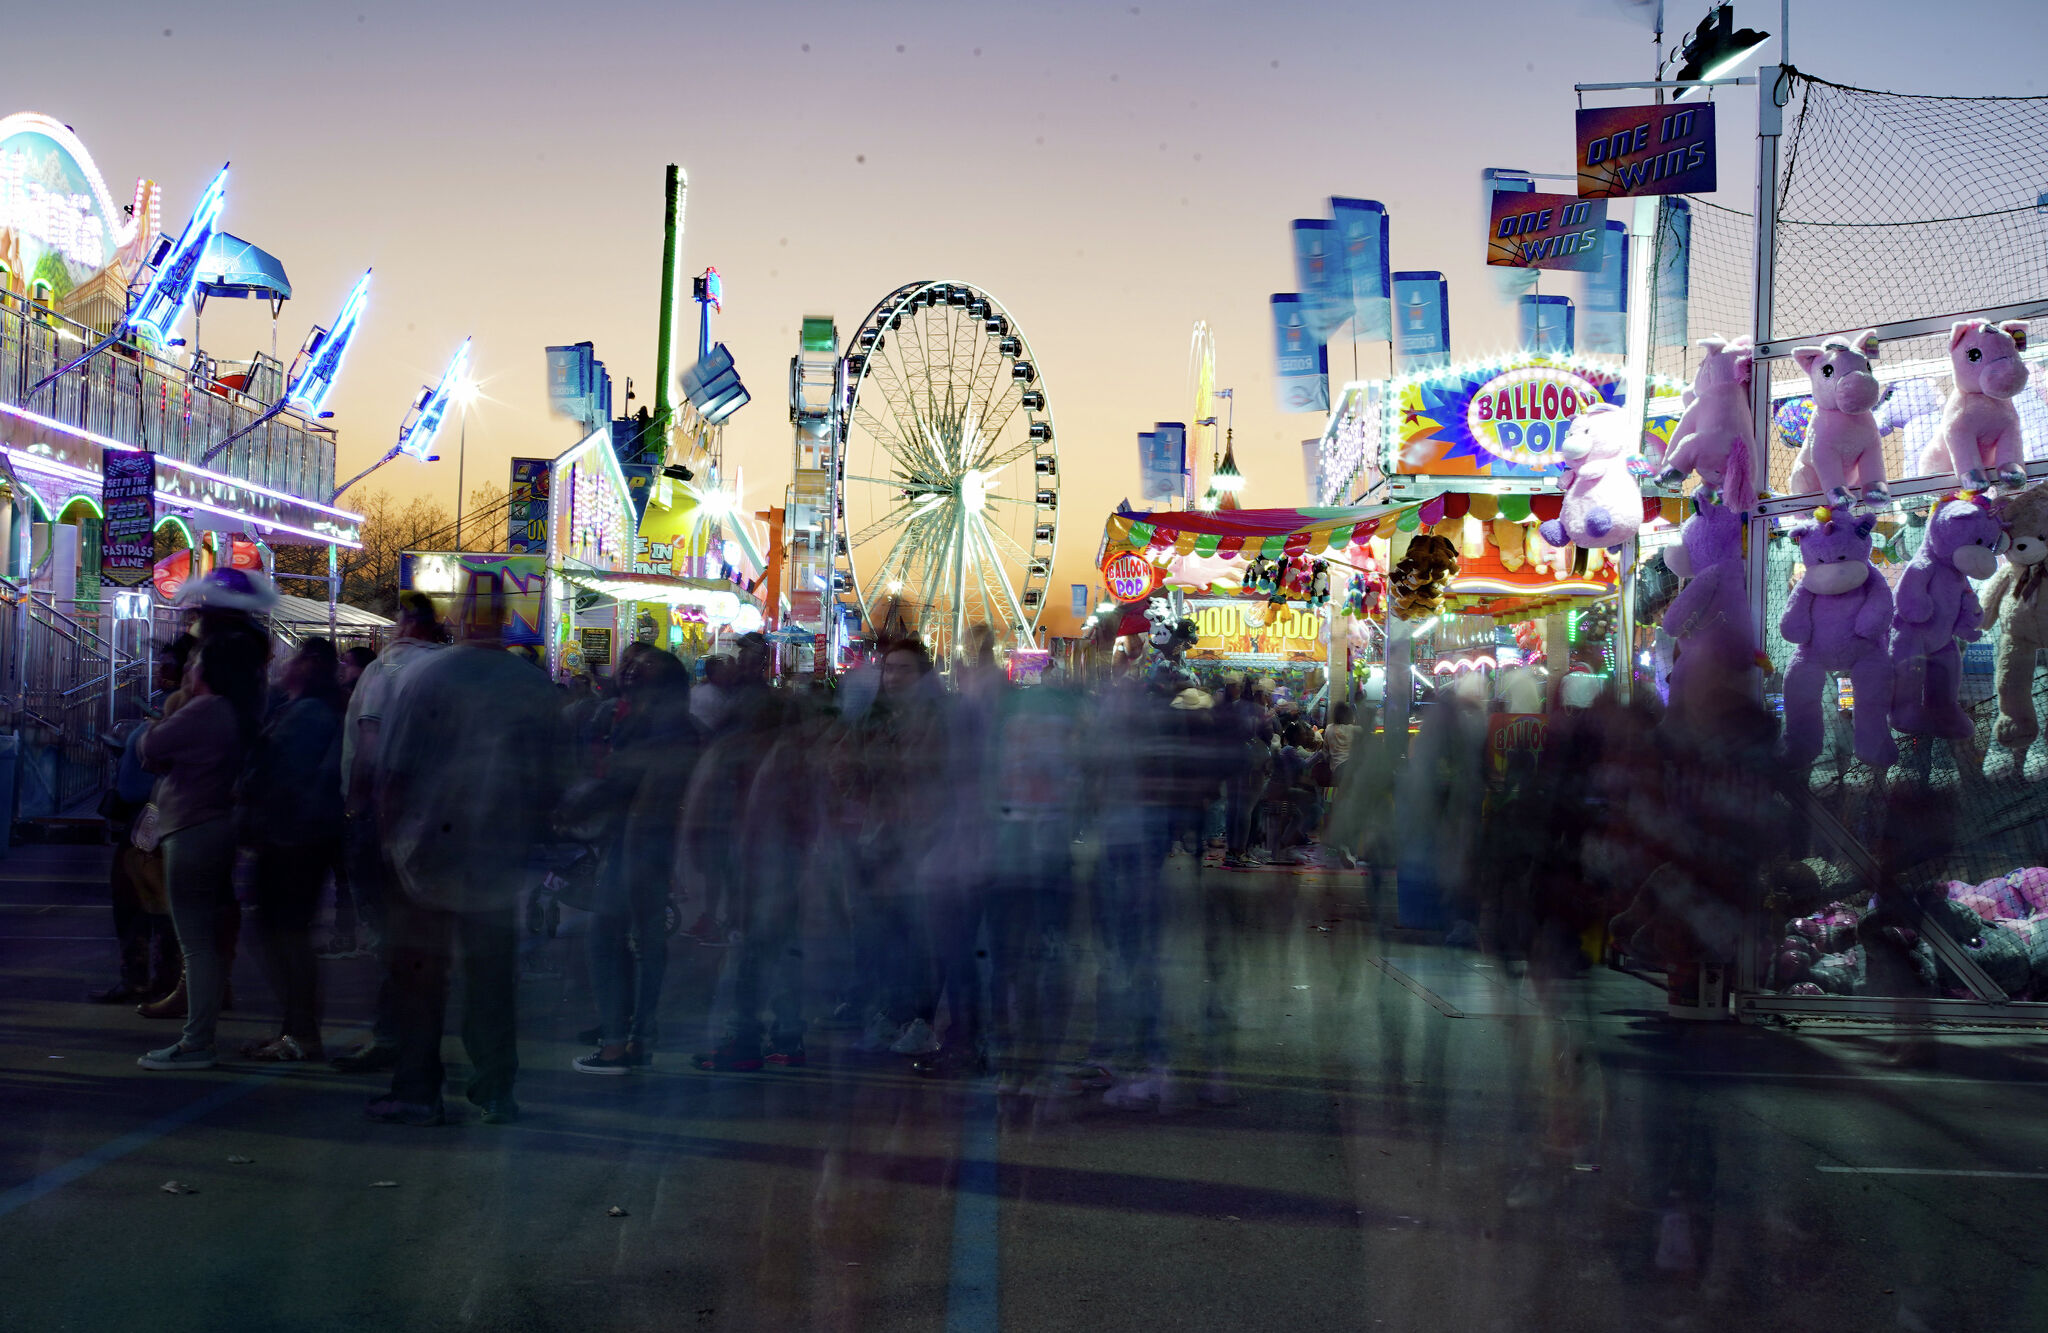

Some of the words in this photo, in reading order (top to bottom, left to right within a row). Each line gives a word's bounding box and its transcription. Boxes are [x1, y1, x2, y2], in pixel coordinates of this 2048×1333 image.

[1587, 123, 1649, 166] ONE
[1660, 109, 1695, 144] IN
[1617, 141, 1706, 191] WINS
[1497, 208, 1553, 238] ONE
[1560, 201, 1592, 227] IN
[1522, 228, 1598, 262] WINS
[106, 478, 121, 489] GET
[122, 477, 132, 487] IN
[133, 476, 147, 486] THE
[105, 488, 124, 498] FAST
[107, 502, 147, 520] FAST
[108, 518, 151, 537] PASS
[528, 518, 548, 541] ON
[102, 544, 154, 558] FASTPASS
[651, 542, 673, 561] IN
[111, 557, 145, 568] LANE
[635, 562, 673, 575] INS
[1108, 557, 1149, 579] BALLOON
[1115, 578, 1143, 596] POP
[1183, 603, 1250, 637] HOOT
[1266, 608, 1325, 641] HOO
[1494, 719, 1548, 752] BALLOO
